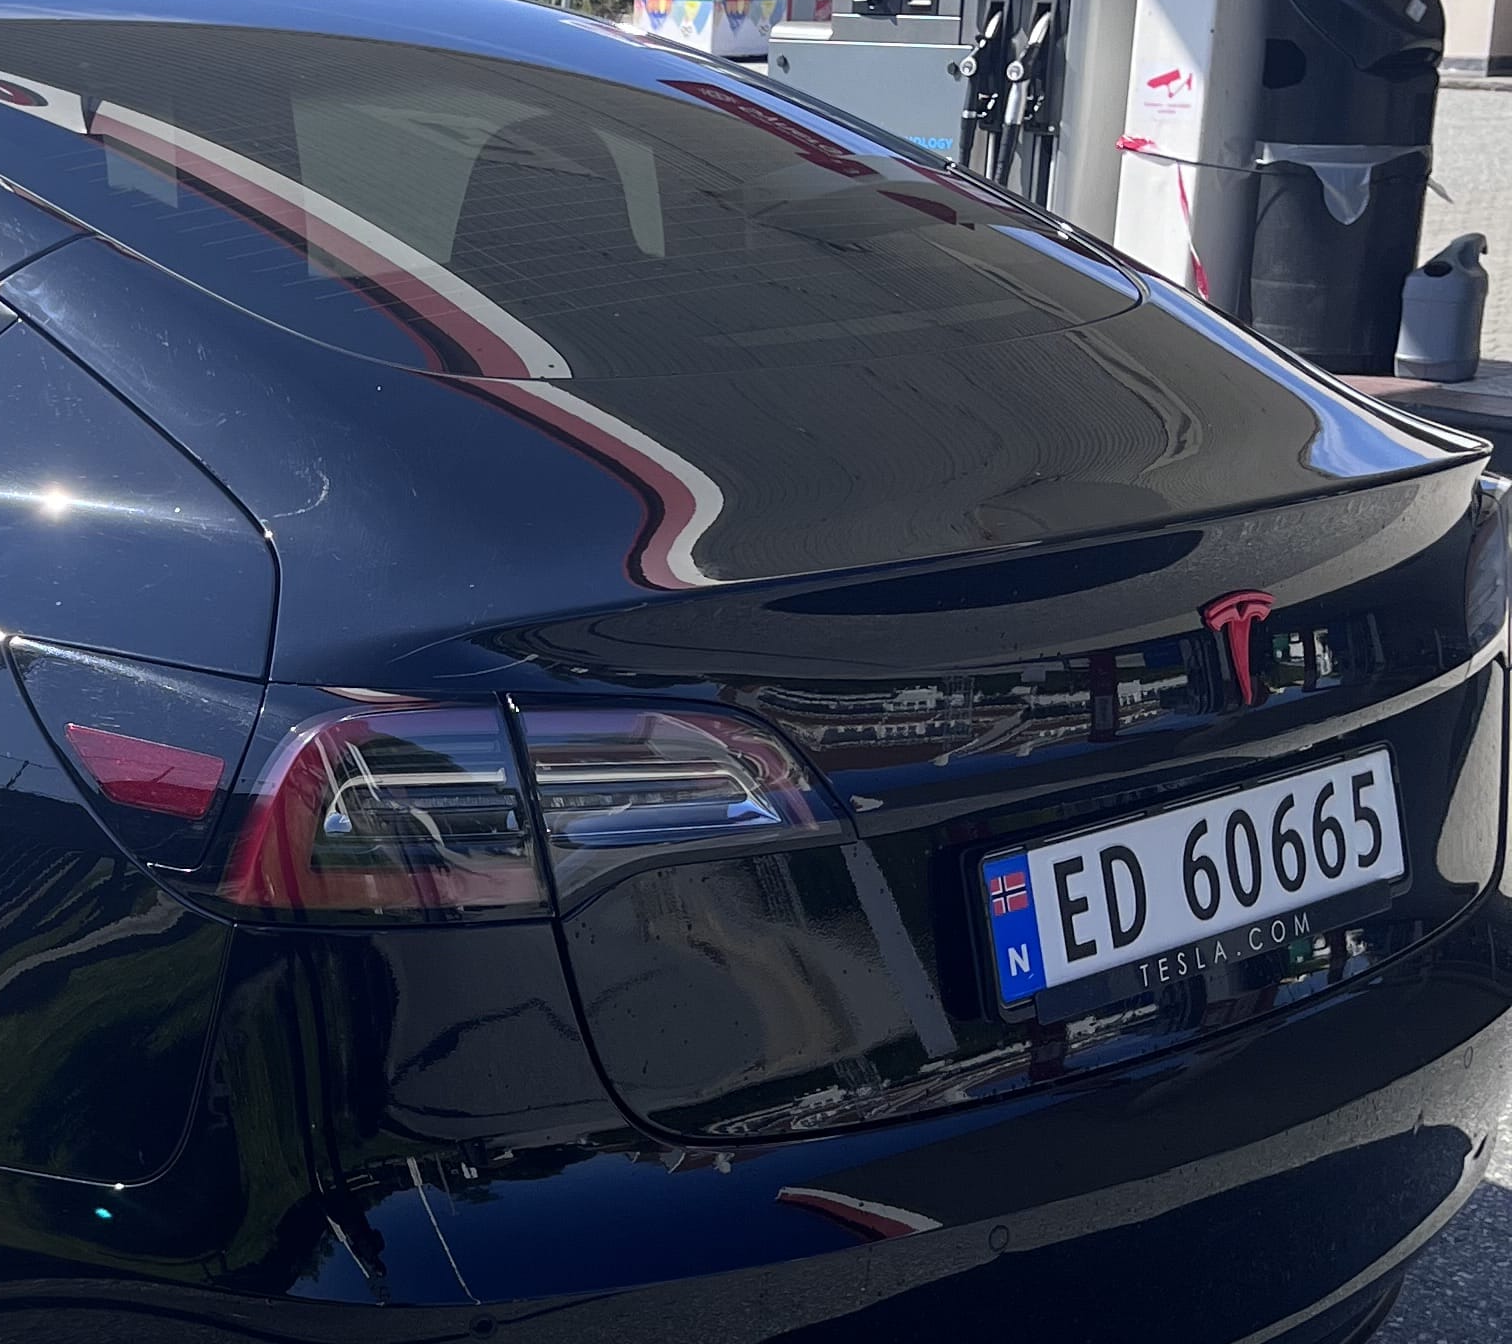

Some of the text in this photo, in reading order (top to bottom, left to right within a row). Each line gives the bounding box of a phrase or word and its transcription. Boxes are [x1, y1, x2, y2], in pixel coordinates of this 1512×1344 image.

[1052, 769, 1384, 963] ED 60665
[1007, 943, 1031, 978] N
[1139, 912, 1311, 988] TESLA.COM
